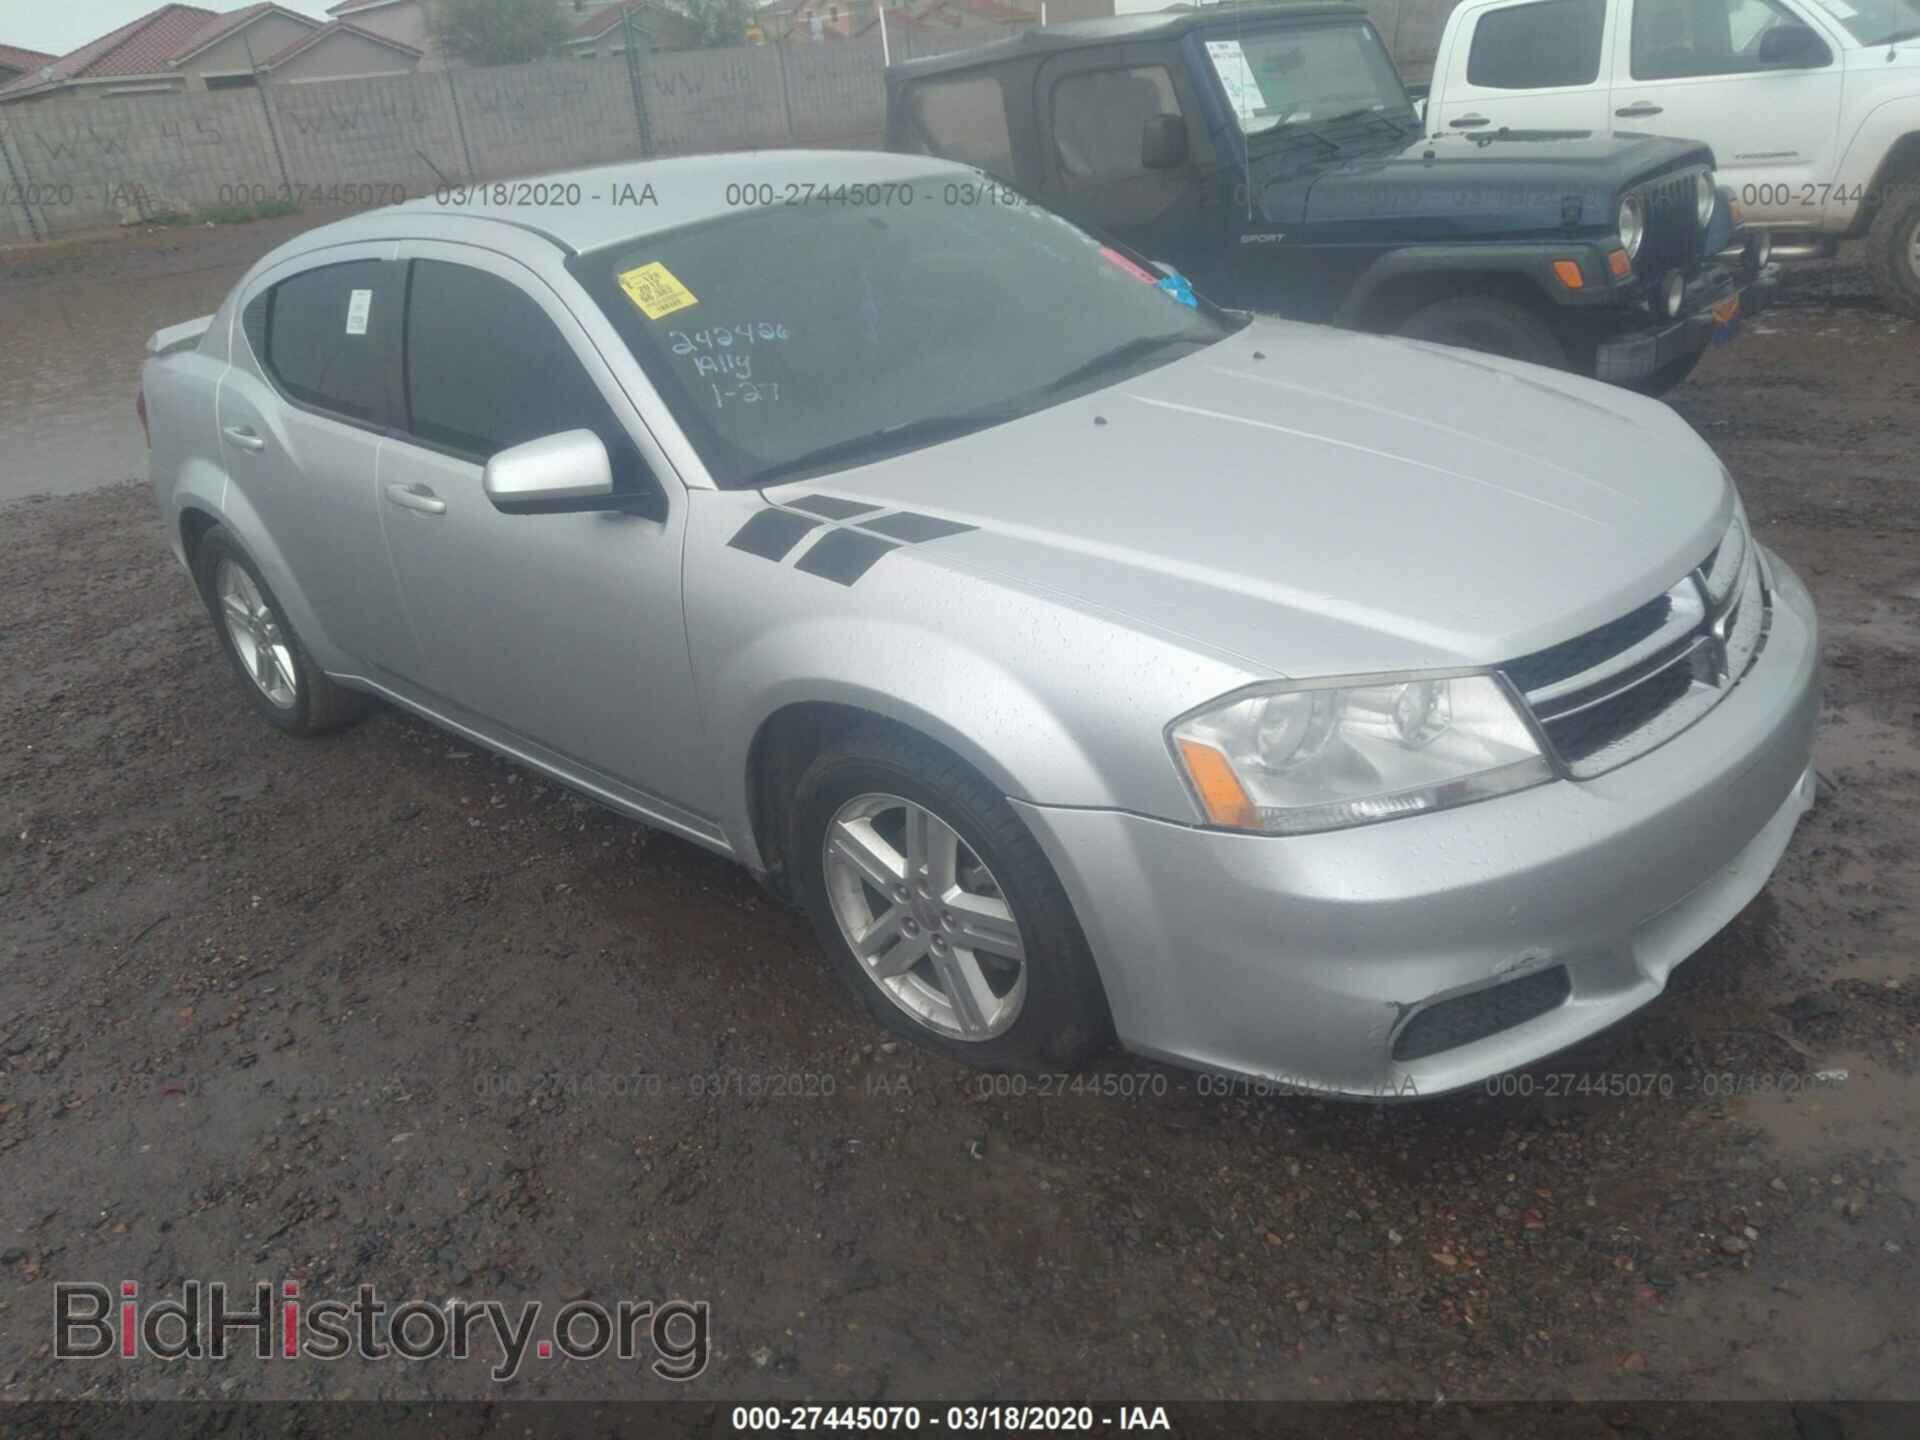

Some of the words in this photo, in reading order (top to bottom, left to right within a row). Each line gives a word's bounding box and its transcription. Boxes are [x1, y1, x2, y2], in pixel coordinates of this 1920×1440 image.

[1239, 232, 1287, 245] SPORT
[668, 322, 792, 355] 242426
[712, 382, 780, 408] 1-27
